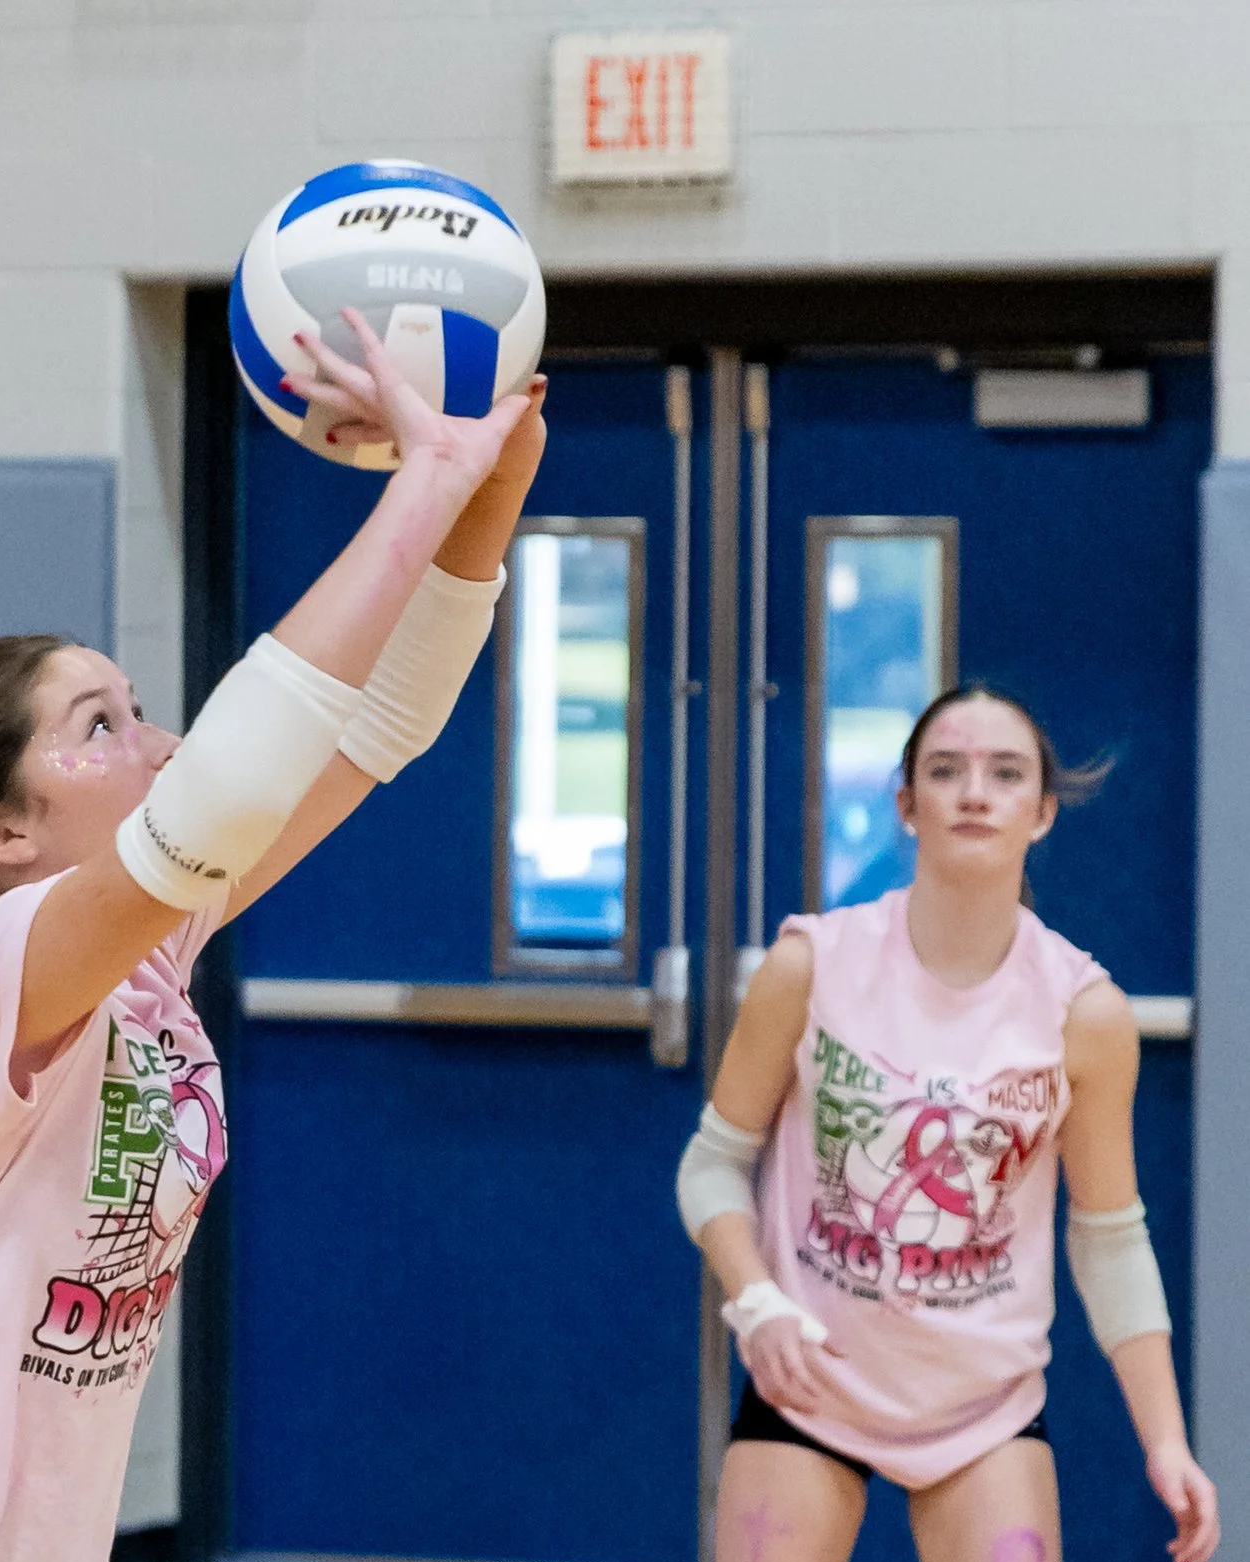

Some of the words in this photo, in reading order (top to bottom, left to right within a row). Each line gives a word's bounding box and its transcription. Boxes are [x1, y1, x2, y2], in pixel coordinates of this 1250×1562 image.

[583, 54, 702, 152] EXIT
[336, 203, 479, 241] Baden
[100, 1089, 125, 1184] PIRATES
[32, 1276, 150, 1360] DIG
[20, 1353, 74, 1386] RIVALS
[77, 1368, 95, 1388] ON
